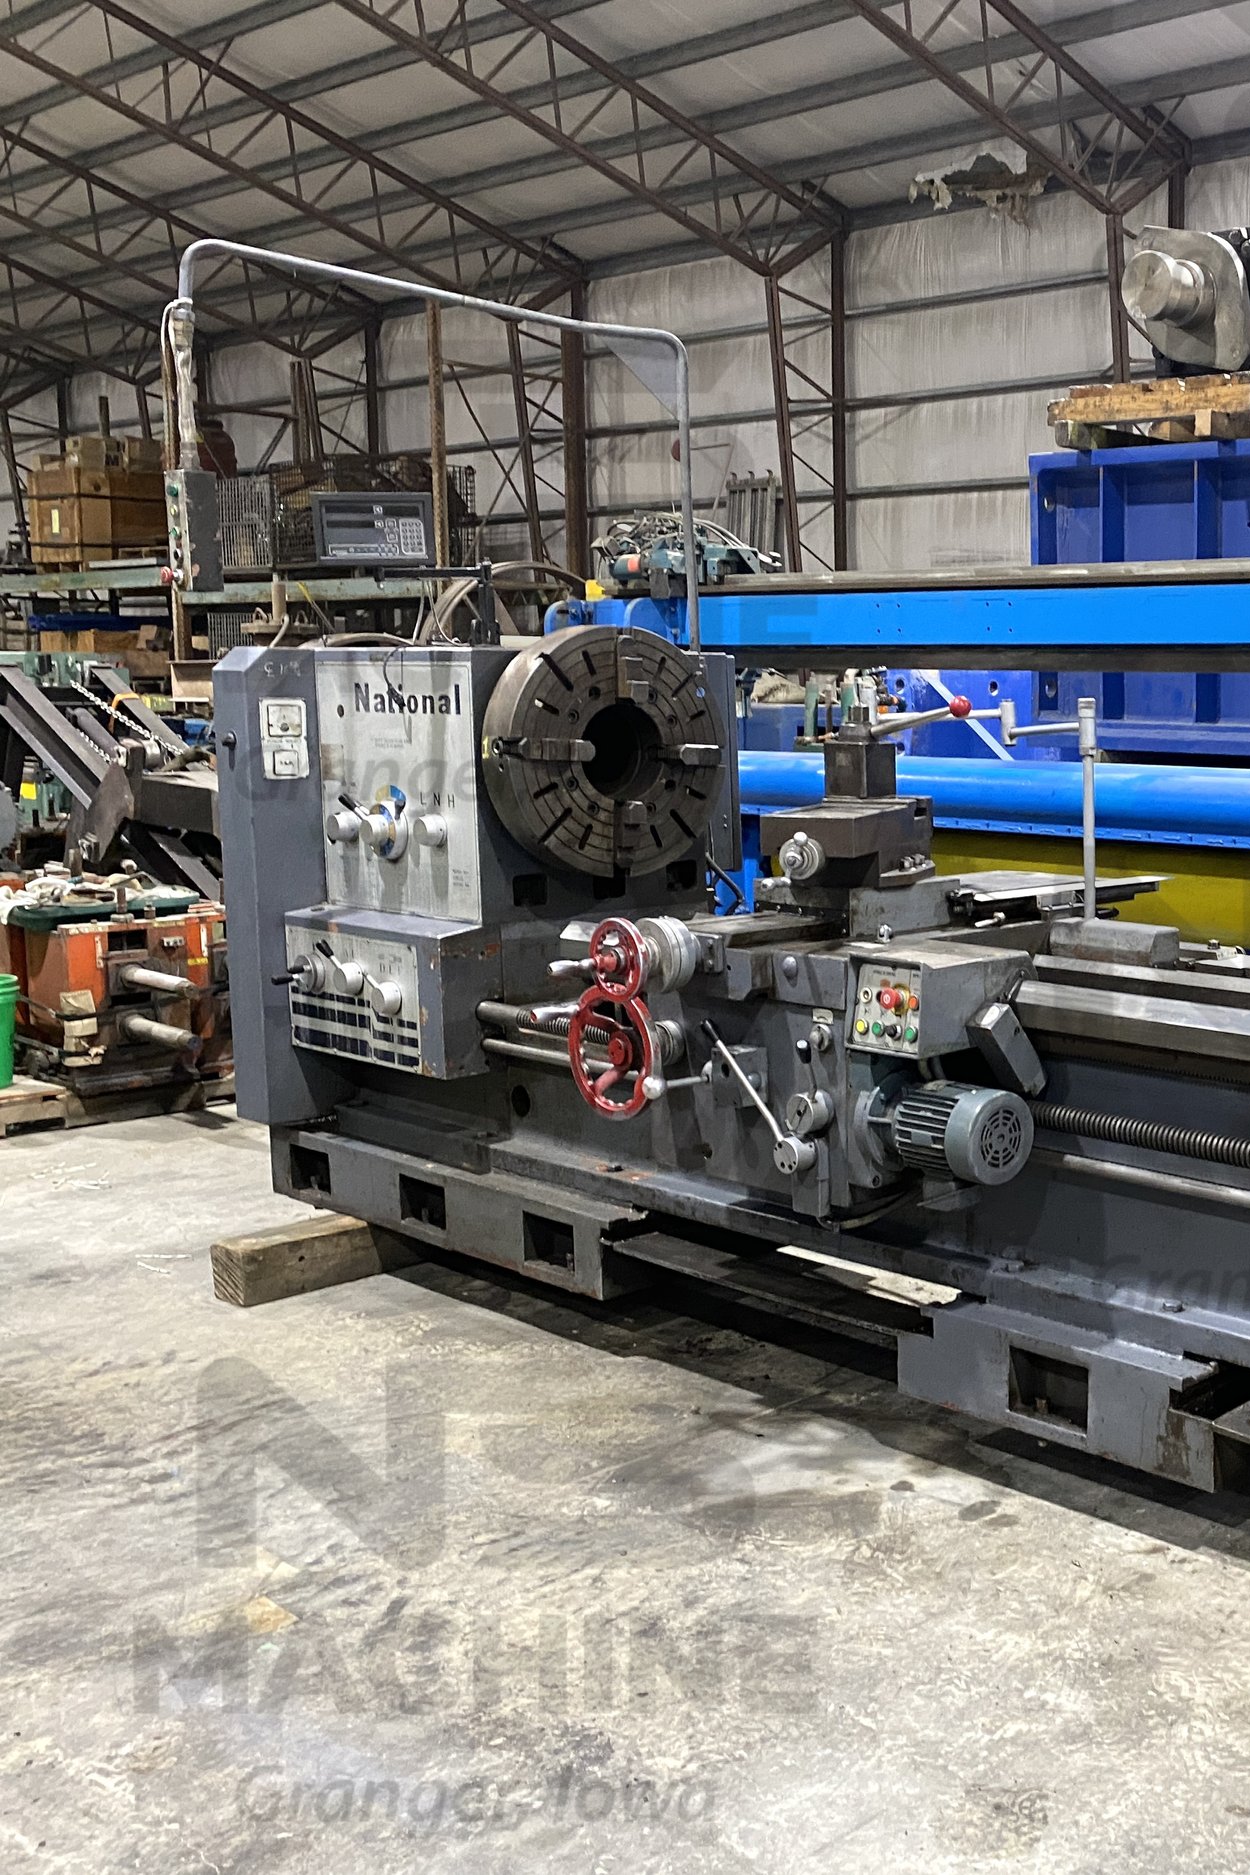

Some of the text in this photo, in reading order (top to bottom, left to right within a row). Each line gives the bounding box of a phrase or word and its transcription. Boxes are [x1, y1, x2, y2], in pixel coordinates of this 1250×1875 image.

[419, 792, 456, 808] L N H
